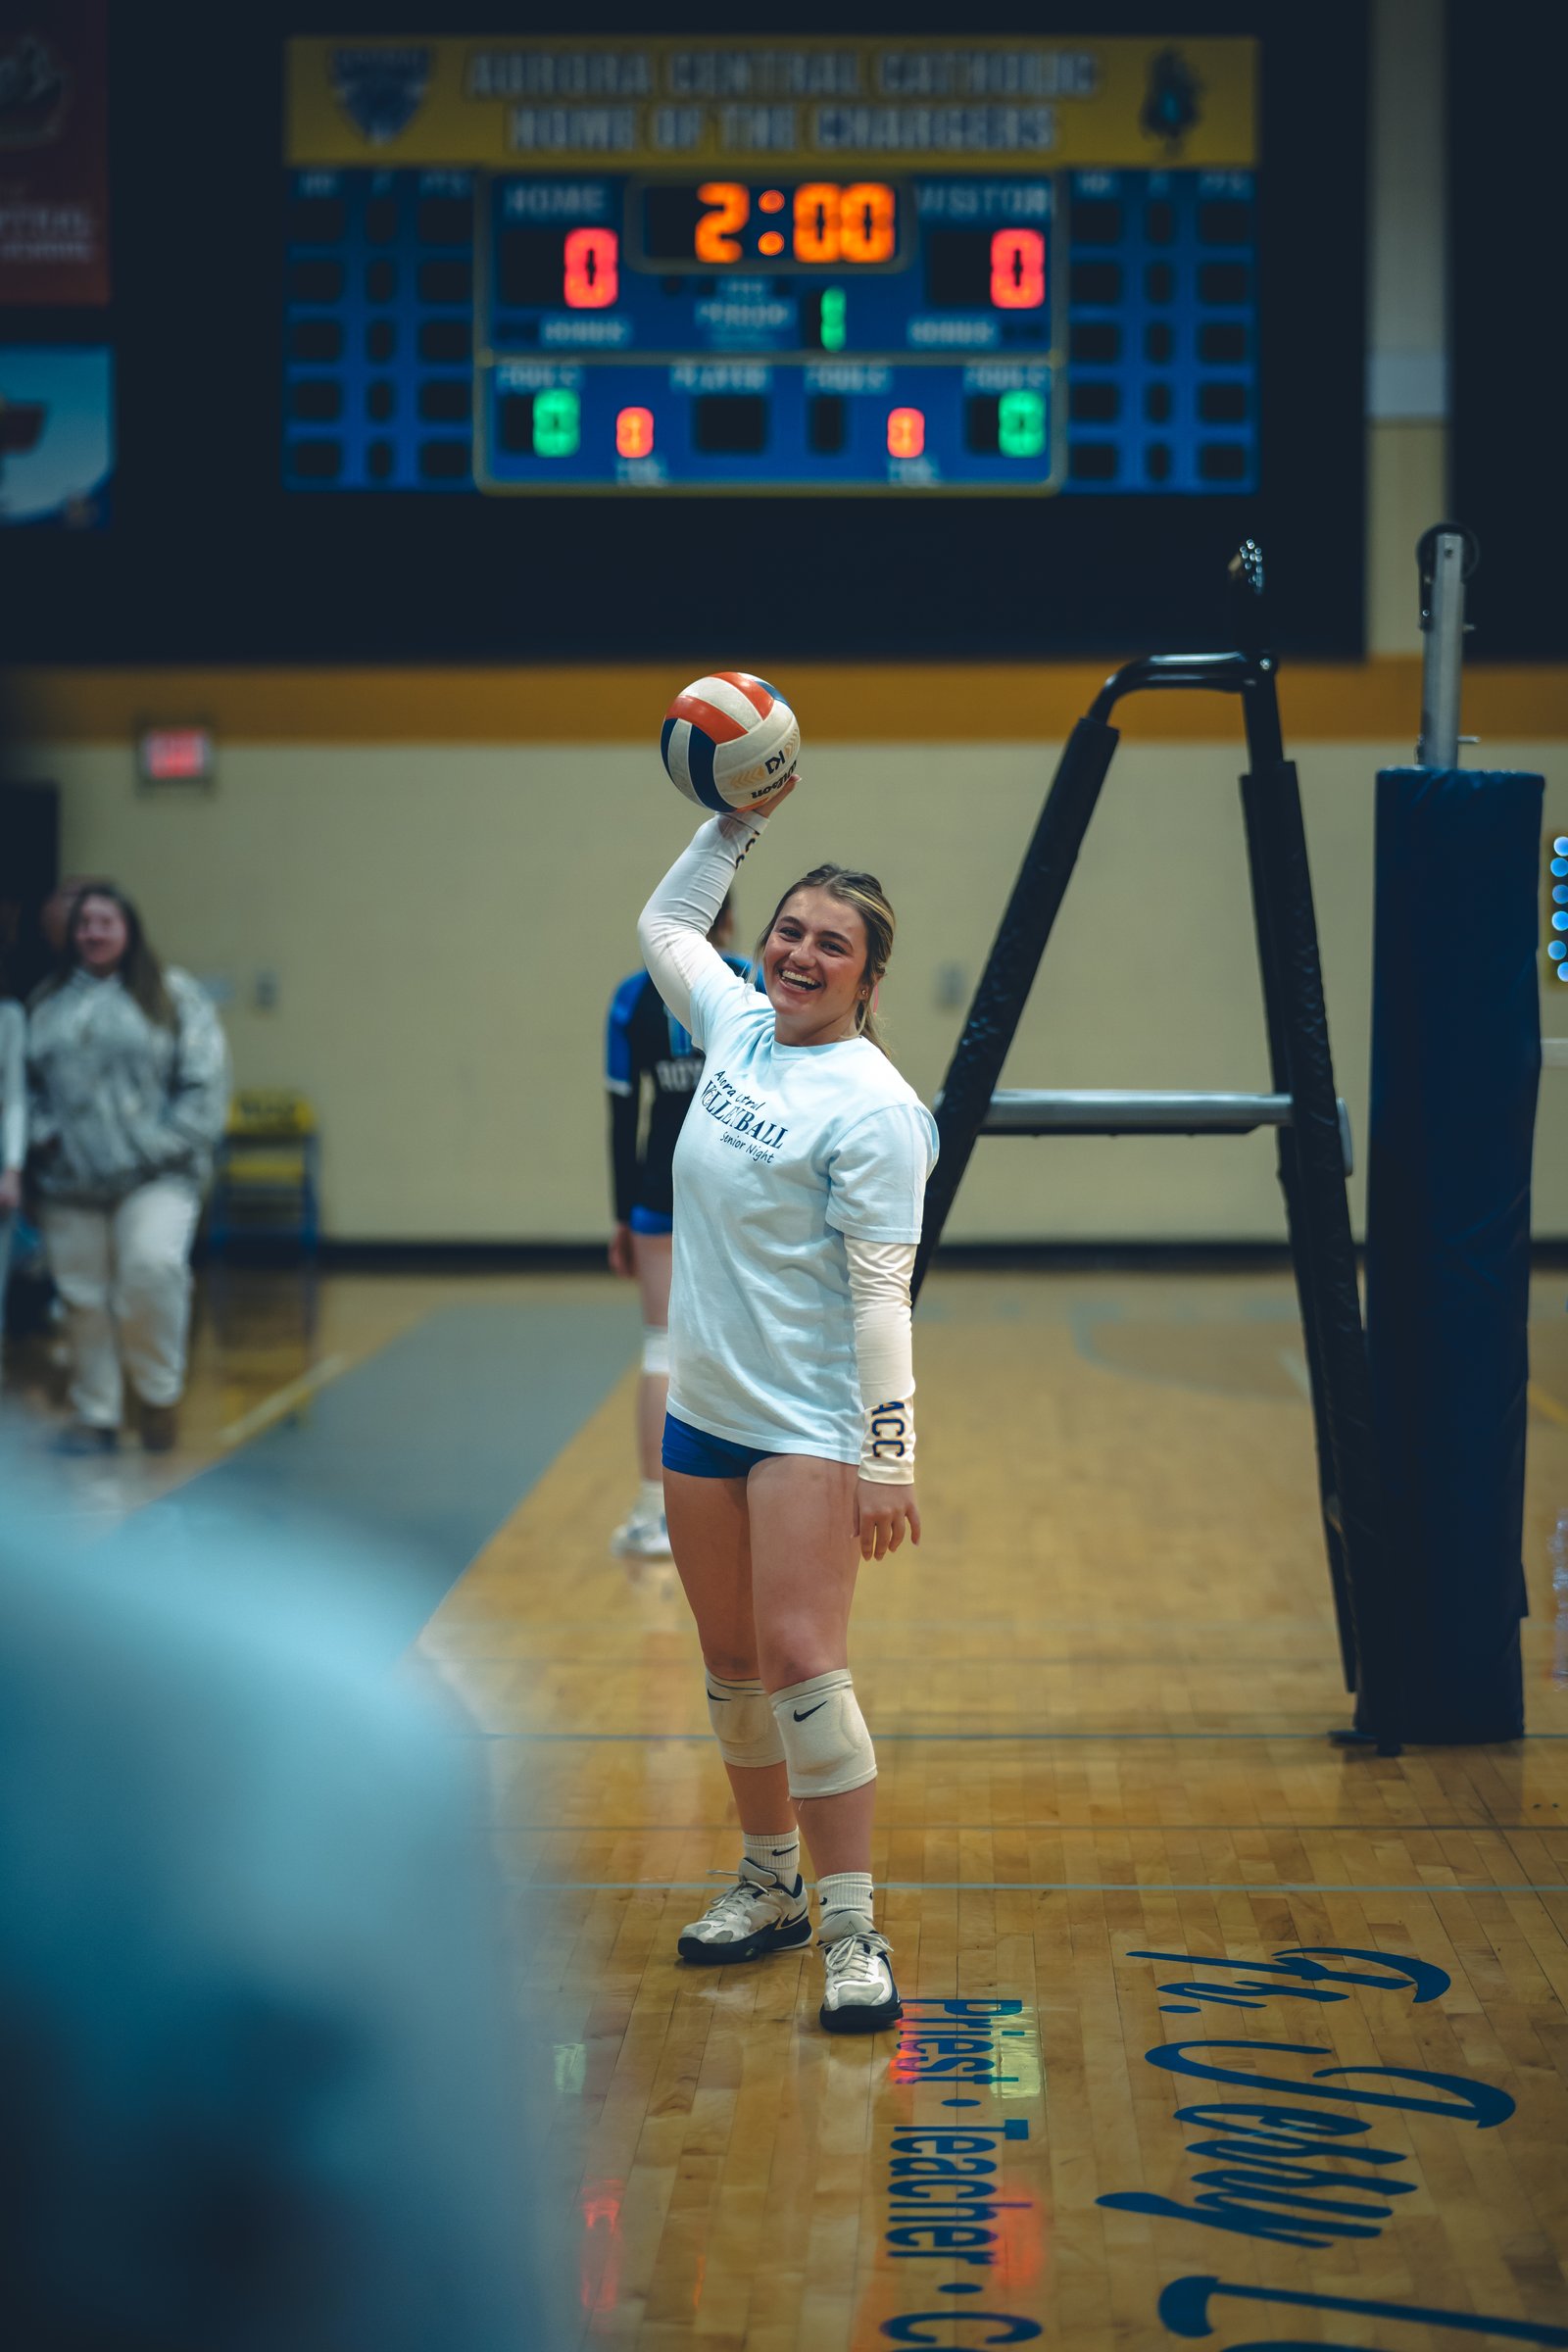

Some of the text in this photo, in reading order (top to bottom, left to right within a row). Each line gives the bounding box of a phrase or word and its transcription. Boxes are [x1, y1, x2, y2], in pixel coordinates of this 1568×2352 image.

[695, 182, 895, 263] 2:00
[564, 227, 618, 309] 0
[990, 228, 1045, 309] 0
[719, 1131, 775, 1164] Senior Night
[871, 1400, 906, 1457] ACC
[879, 1999, 1043, 2352] Priest Teacher C
[1095, 2039, 1516, 2248] Jerry
